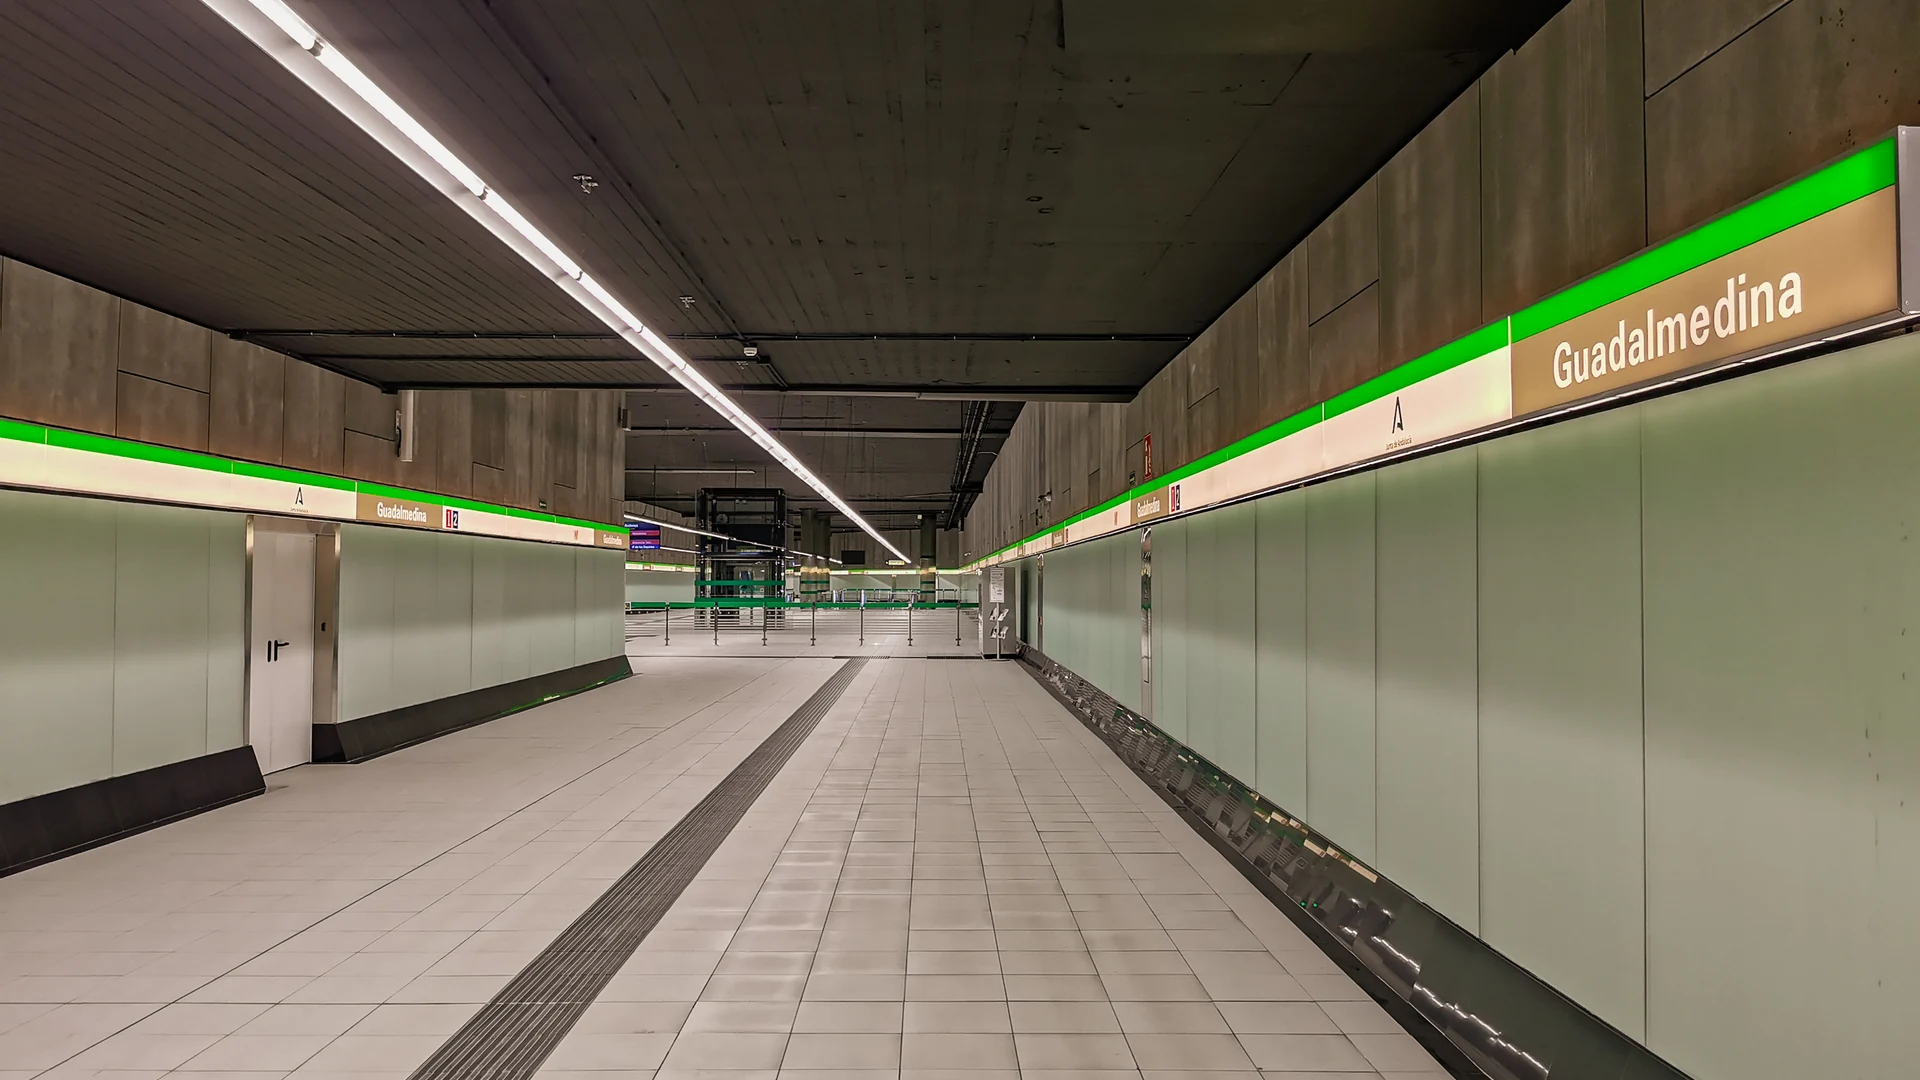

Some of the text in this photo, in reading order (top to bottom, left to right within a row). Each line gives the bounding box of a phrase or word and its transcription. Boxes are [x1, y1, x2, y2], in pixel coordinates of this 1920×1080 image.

[1553, 271, 1803, 389] Guadalmedina
[377, 501, 427, 523] Guadalmedina
[453, 512, 458, 527] 2
